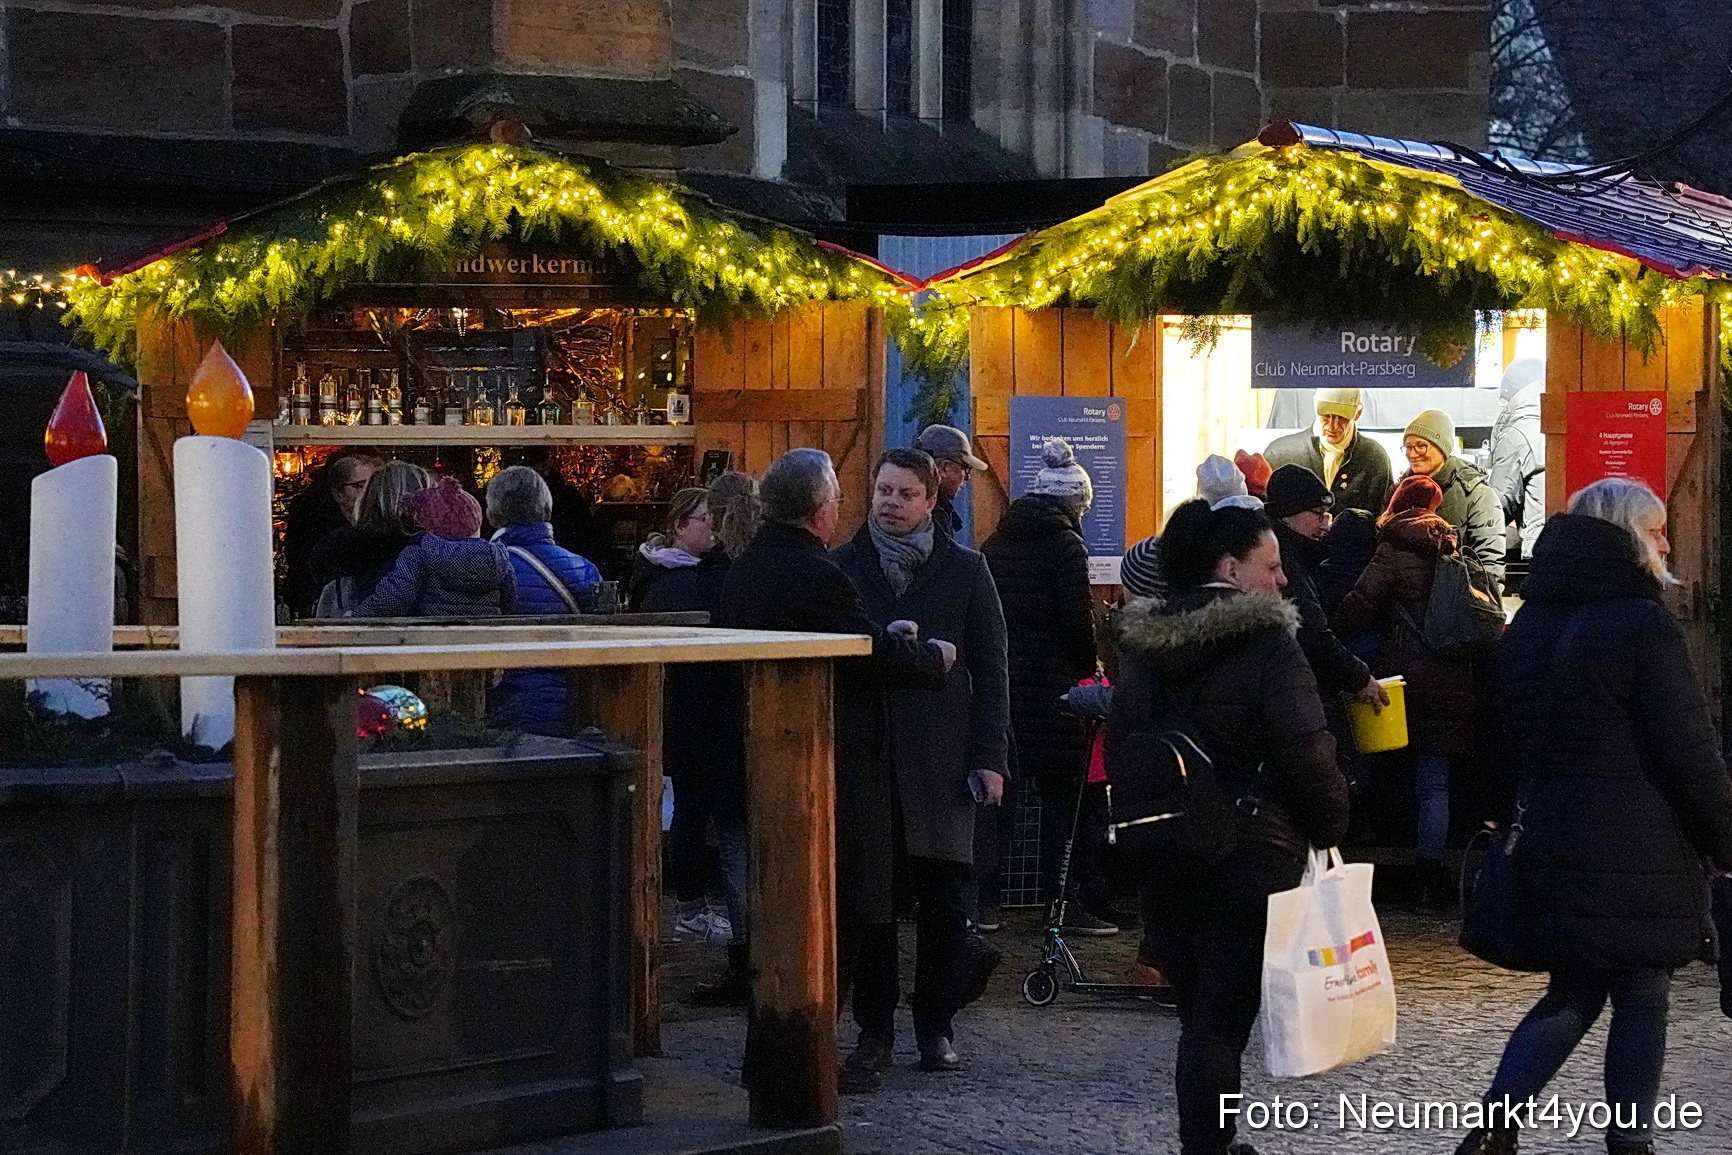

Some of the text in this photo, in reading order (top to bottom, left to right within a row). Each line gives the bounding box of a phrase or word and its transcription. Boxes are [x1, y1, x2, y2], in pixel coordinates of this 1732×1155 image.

[1340, 331, 1416, 358] Rotary
[1255, 361, 1416, 380] Club Neumarkt-Parsberg
[1083, 407, 1106, 417] Rotary
[1628, 403, 1648, 411] Rotary
[1029, 434, 1041, 442] Wir
[1084, 434, 1109, 443] herzlich
